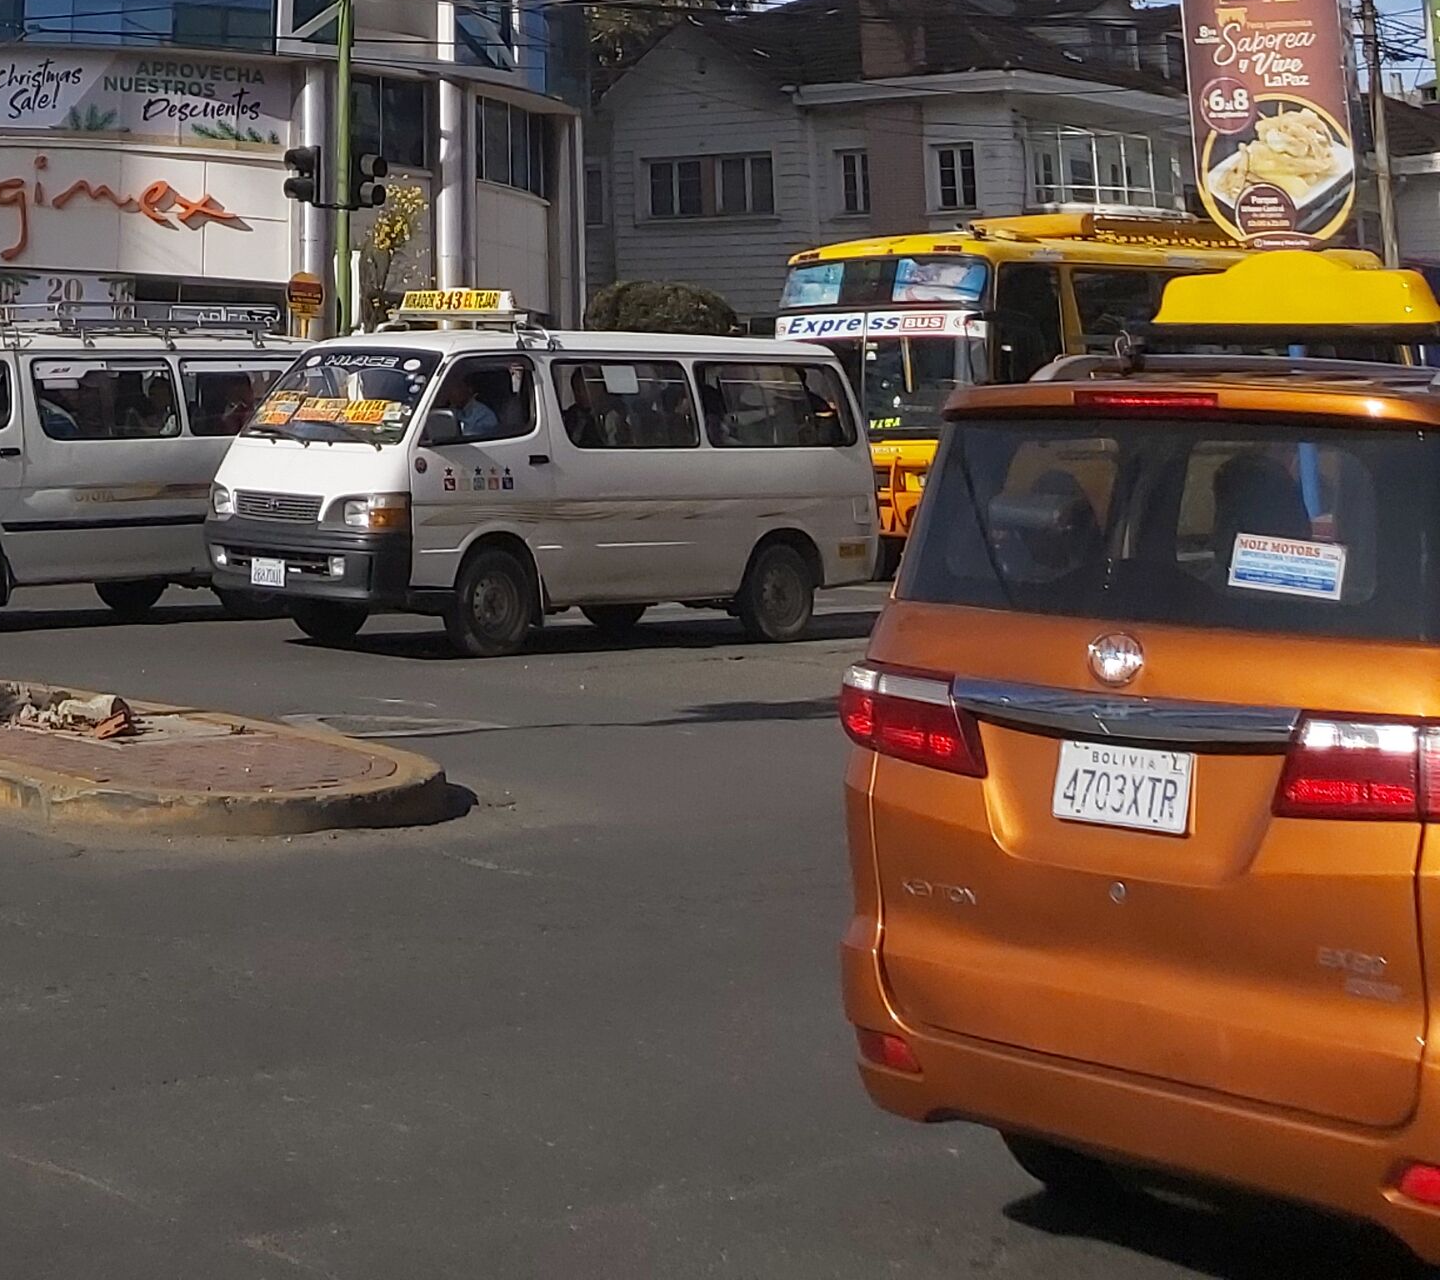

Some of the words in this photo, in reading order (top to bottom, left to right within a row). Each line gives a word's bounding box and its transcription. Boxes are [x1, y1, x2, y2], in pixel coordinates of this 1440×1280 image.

[136, 61, 265, 85] APROVECHA
[1239, 59, 1249, 73] y
[1252, 51, 1303, 75] Vive
[104, 76, 216, 98] NUESTROS
[8, 86, 59, 119] Sale!
[143, 88, 261, 121] Descuentos
[1209, 89, 1225, 111] 6
[1233, 88, 1249, 111] 8
[47, 278, 84, 302] 20
[435, 291, 463, 309] 343
[463, 292, 473, 308] EL
[788, 316, 901, 336] Express
[902, 315, 942, 329] BUS
[324, 354, 400, 368] HIACE
[1271, 543, 1321, 558] MOTORS
[1092, 751, 1157, 771] BOLIVIA
[1063, 768, 1178, 820] 4703XTR
